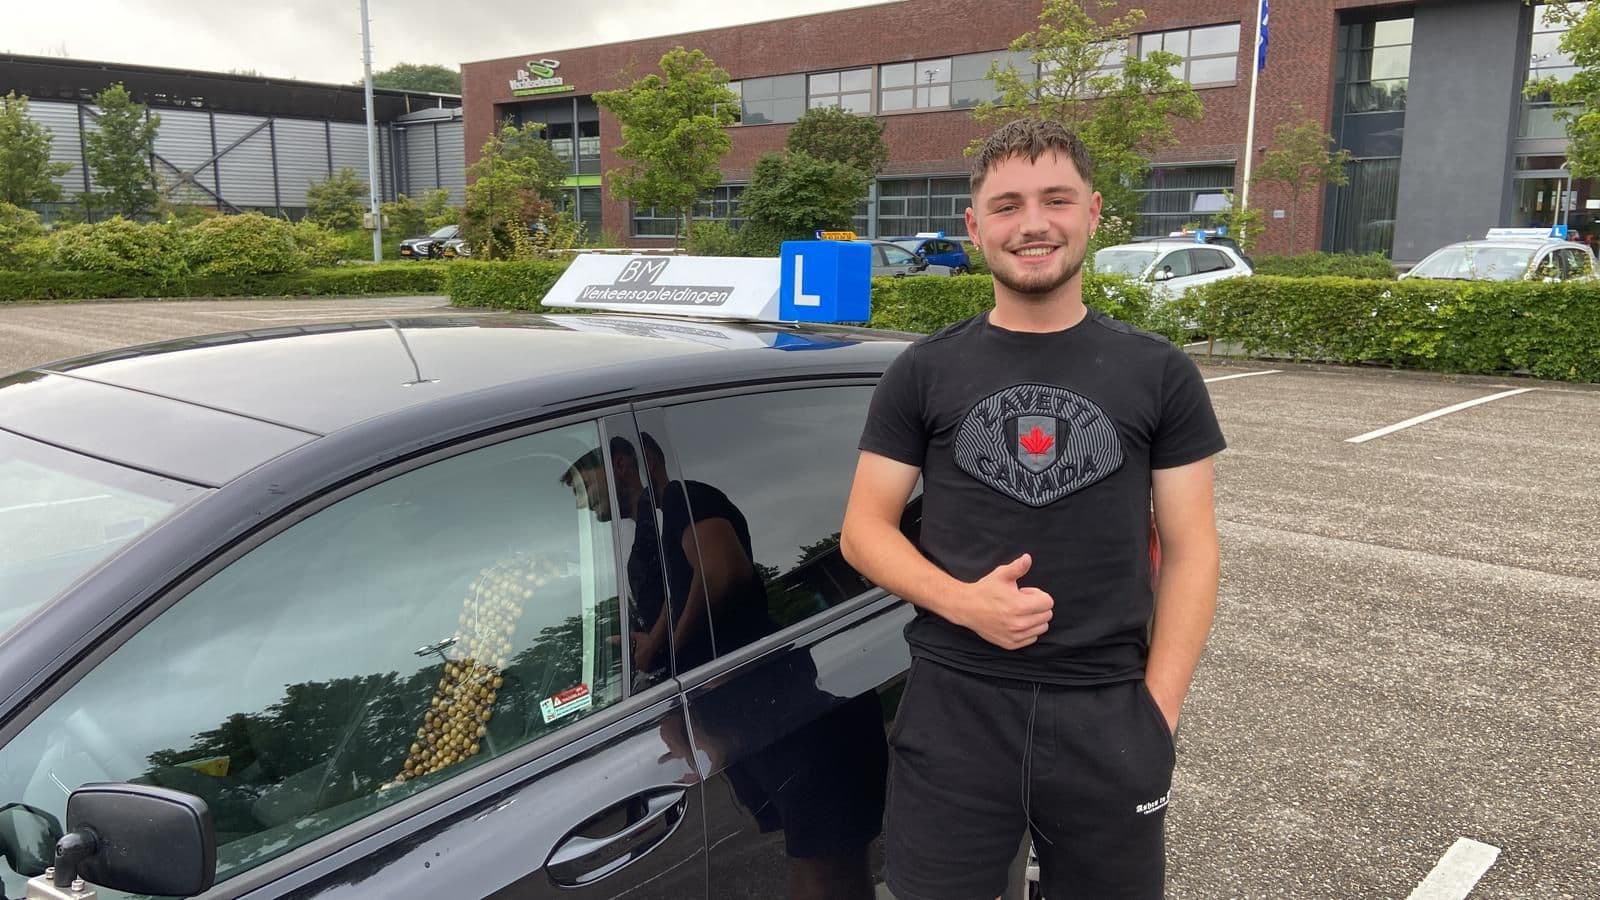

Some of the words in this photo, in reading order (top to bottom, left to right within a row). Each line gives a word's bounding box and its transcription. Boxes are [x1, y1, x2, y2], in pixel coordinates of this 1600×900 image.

[618, 259, 667, 283] BM
[794, 254, 821, 307] L
[581, 286, 729, 305] Verkeersopleidingen
[977, 454, 1098, 494] CANADA
